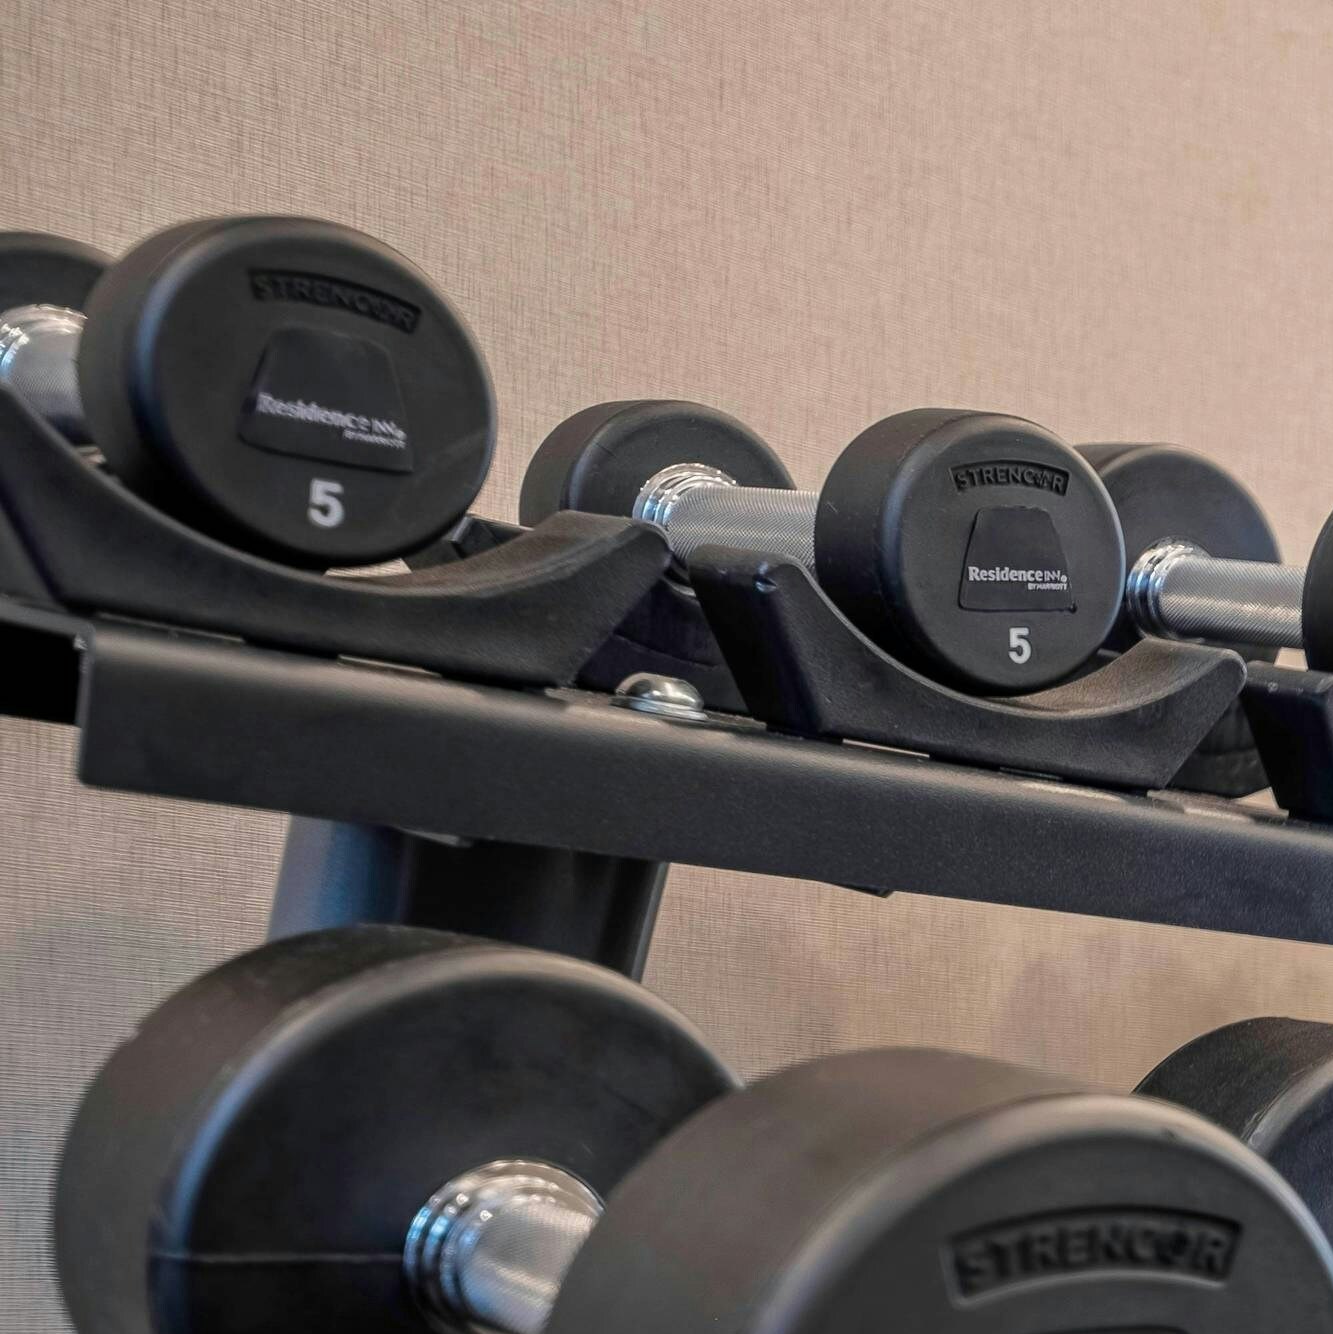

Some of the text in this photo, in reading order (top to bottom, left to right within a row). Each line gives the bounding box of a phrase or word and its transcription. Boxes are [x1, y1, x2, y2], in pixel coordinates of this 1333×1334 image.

[307, 478, 345, 527] 5
[968, 566, 1043, 581] Residence
[1008, 627, 1032, 664] 5
